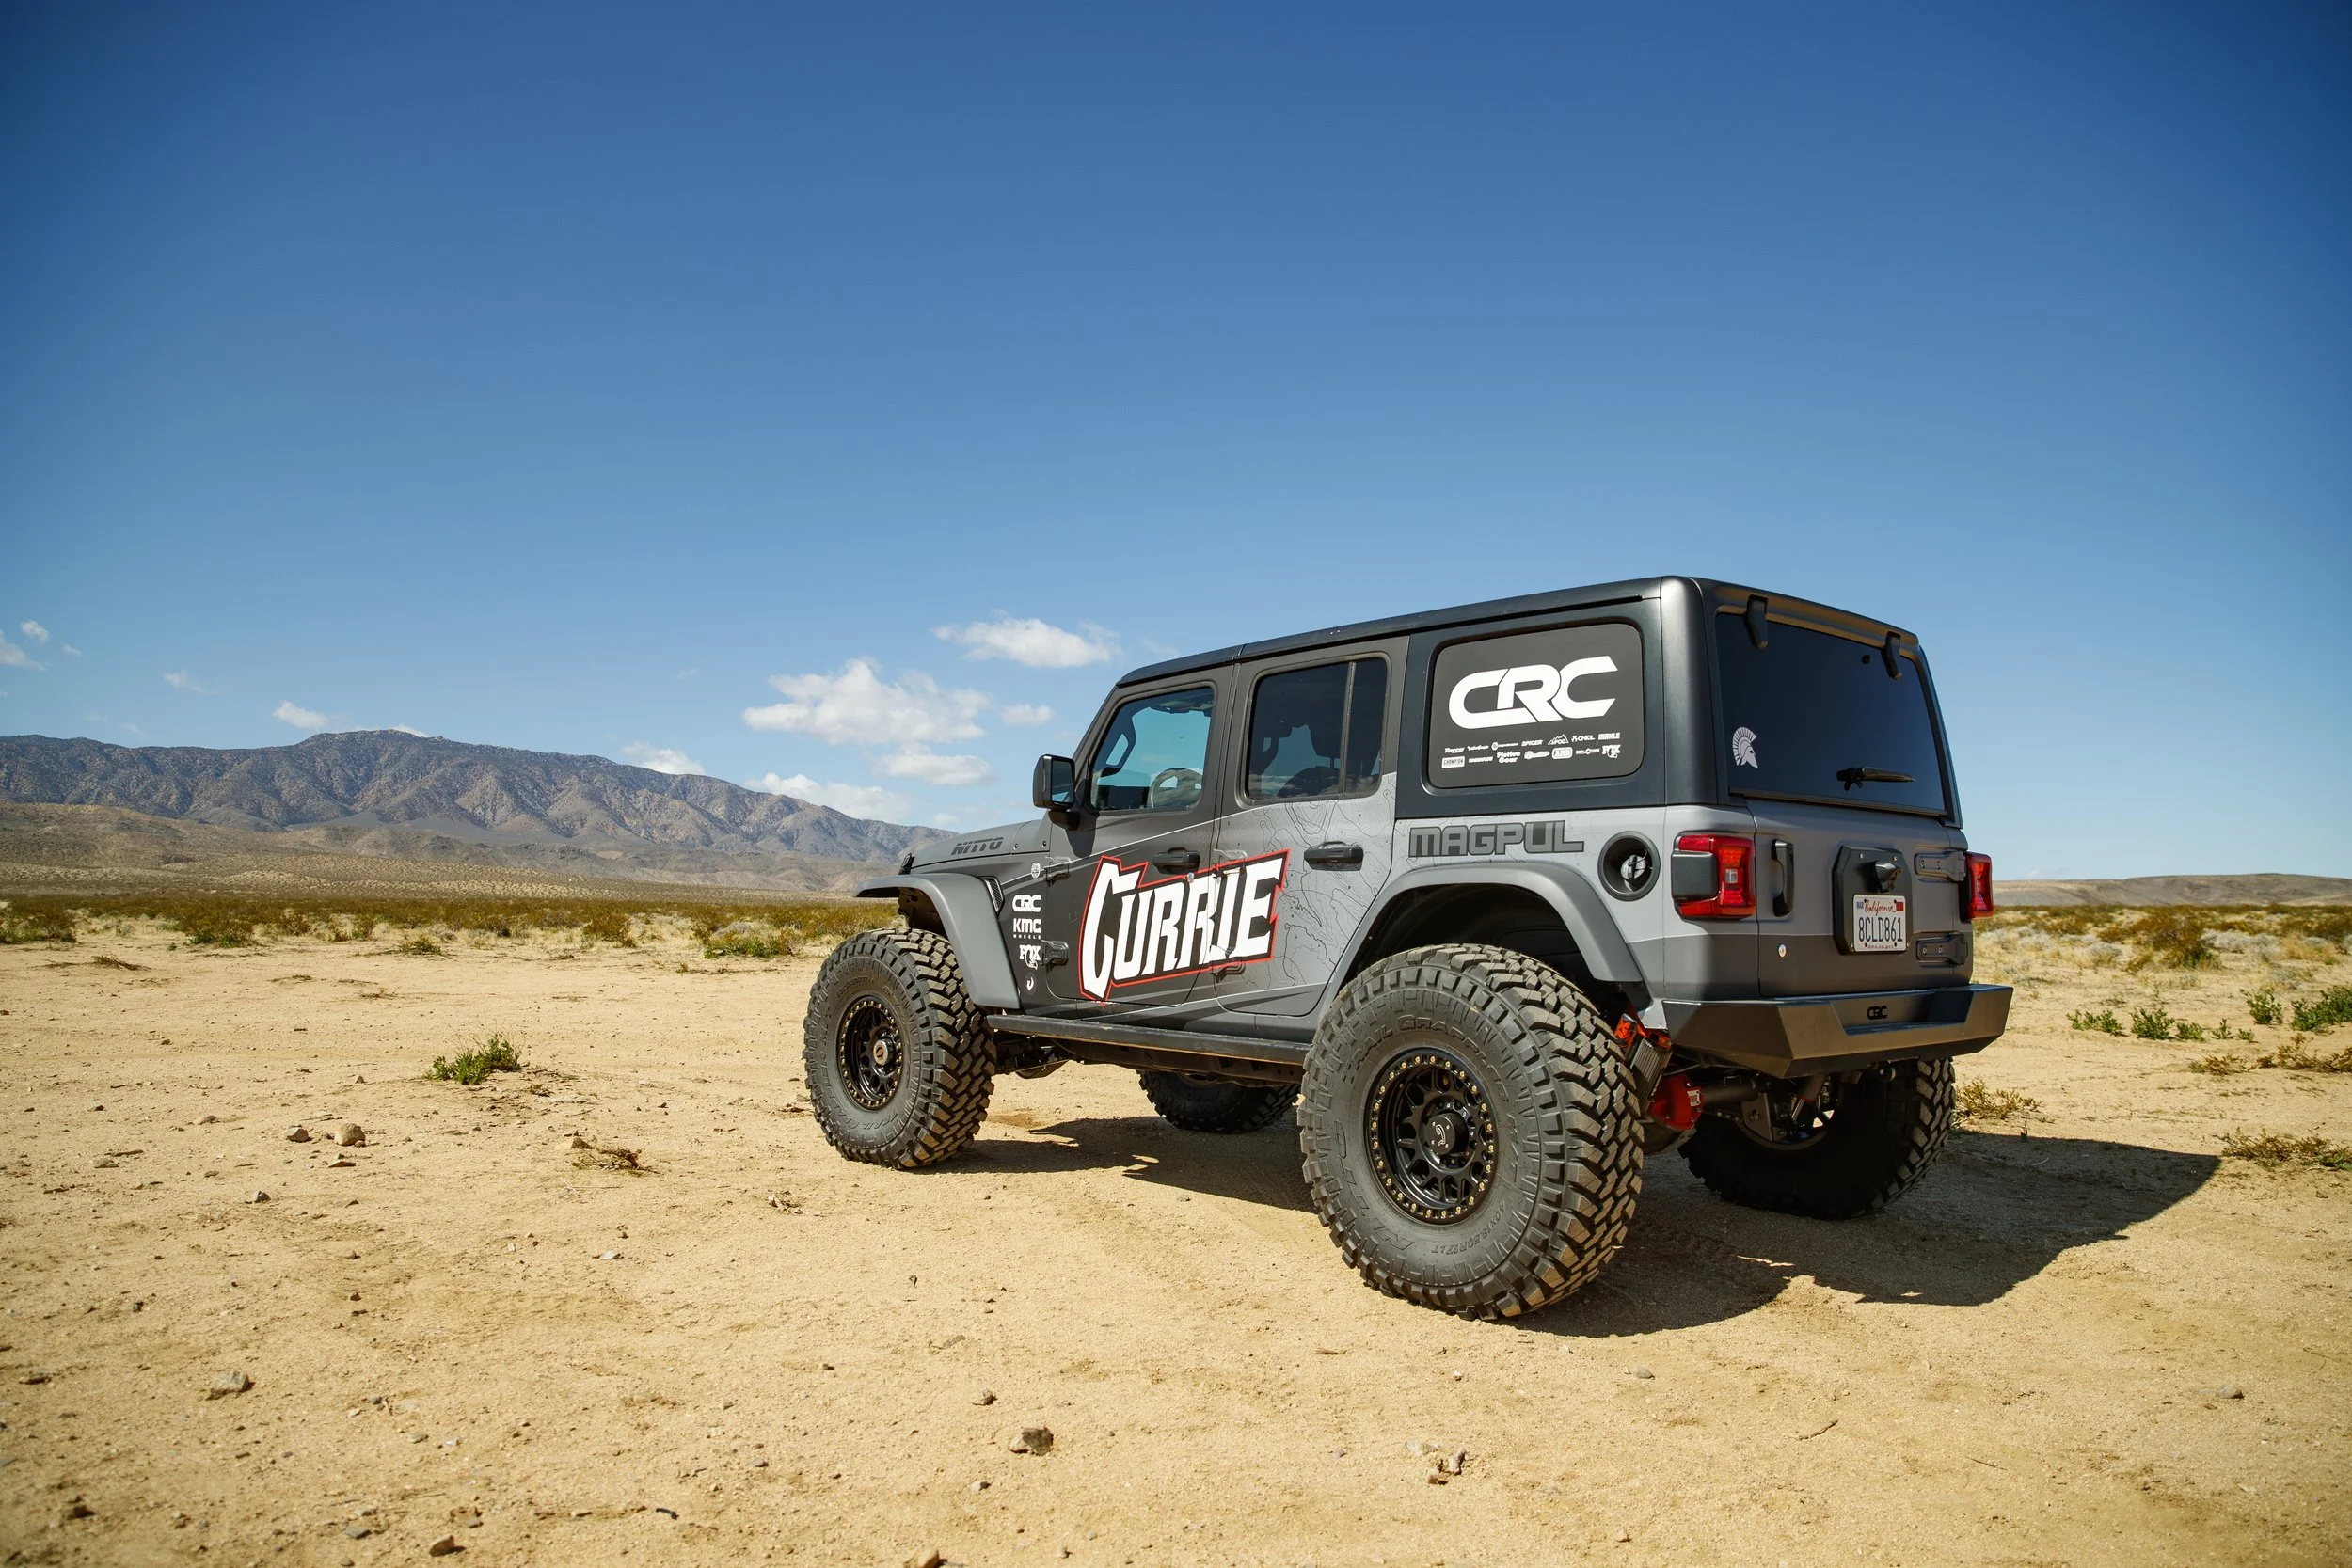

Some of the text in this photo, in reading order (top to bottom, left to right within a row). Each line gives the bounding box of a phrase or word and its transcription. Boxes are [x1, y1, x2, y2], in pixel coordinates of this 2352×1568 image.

[1448, 655, 1619, 730] CRC
[1408, 820, 1584, 858] MAGPUL
[1012, 895, 1042, 912] CRC
[1013, 918, 1041, 933] KMC
[1081, 858, 1284, 1000] CURRIE
[1858, 916, 1903, 942] 8CLD861
[1019, 944, 1041, 965] FOX
[1867, 1006, 1888, 1021] CRC
